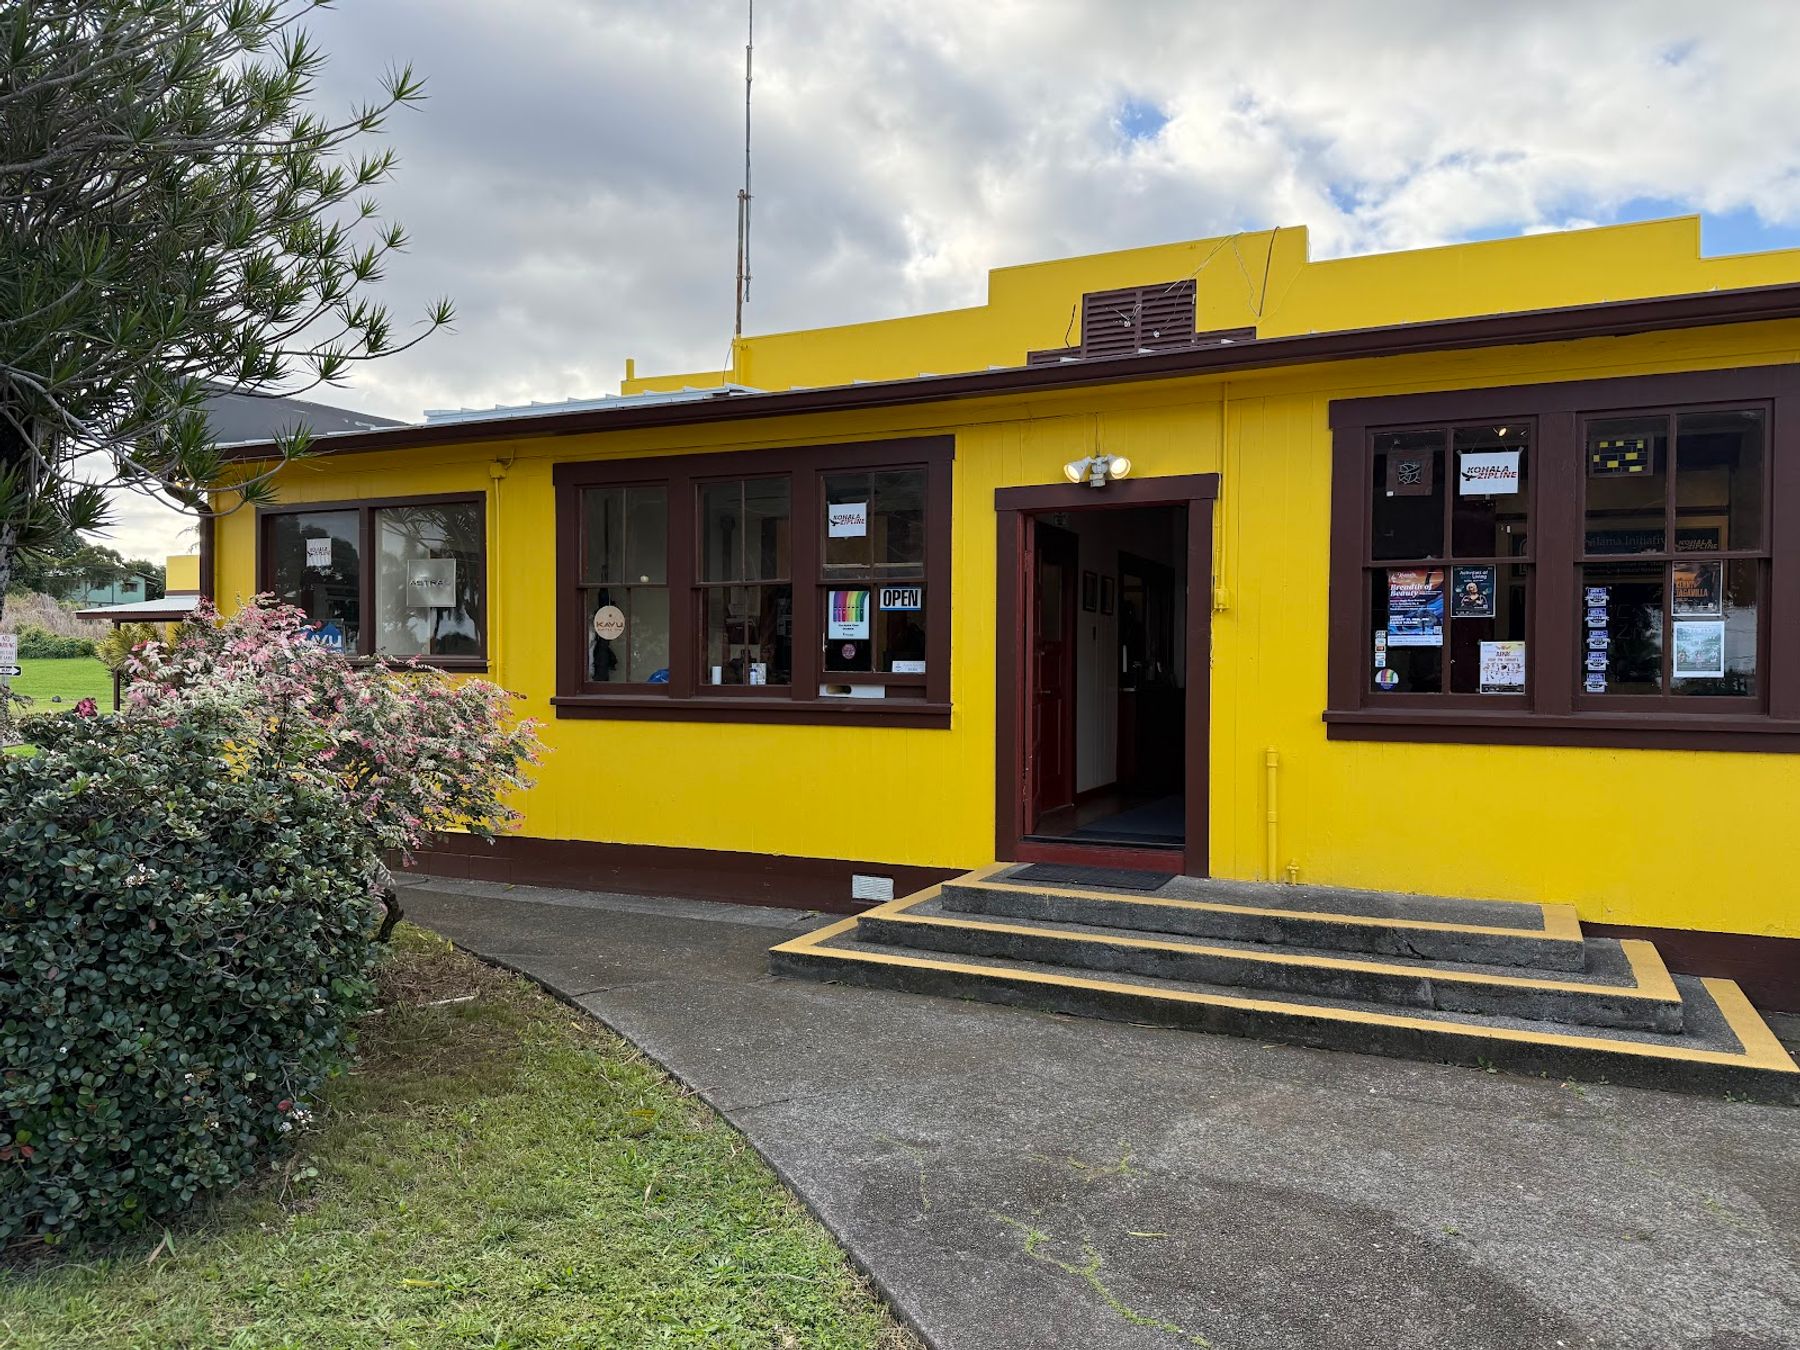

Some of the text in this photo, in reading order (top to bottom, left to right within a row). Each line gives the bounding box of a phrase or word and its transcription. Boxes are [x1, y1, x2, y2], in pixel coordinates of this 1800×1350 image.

[1467, 465, 1509, 473] KOHALA
[1477, 471, 1518, 480] ZIPLINE
[1390, 583, 1423, 591] Breadth
[883, 589, 918, 607] OPEN
[1390, 590, 1419, 598] Beauty
